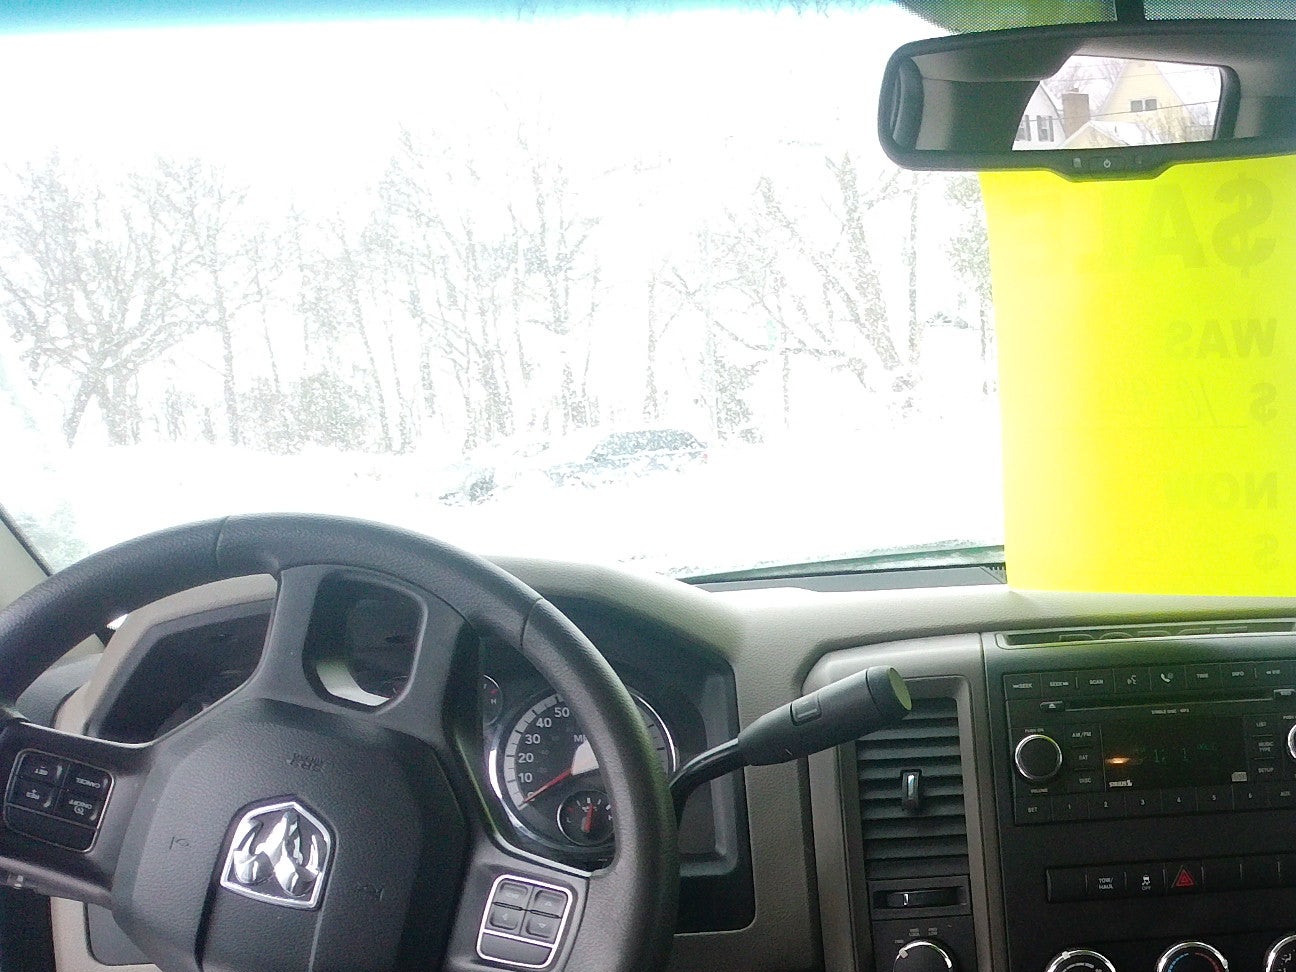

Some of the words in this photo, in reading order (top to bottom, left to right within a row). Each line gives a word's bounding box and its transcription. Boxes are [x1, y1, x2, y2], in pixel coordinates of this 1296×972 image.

[553, 707, 570, 718] 50
[535, 718, 552, 728] 40
[524, 734, 541, 744] 30
[518, 753, 534, 763] 20
[518, 773, 533, 783] 10
